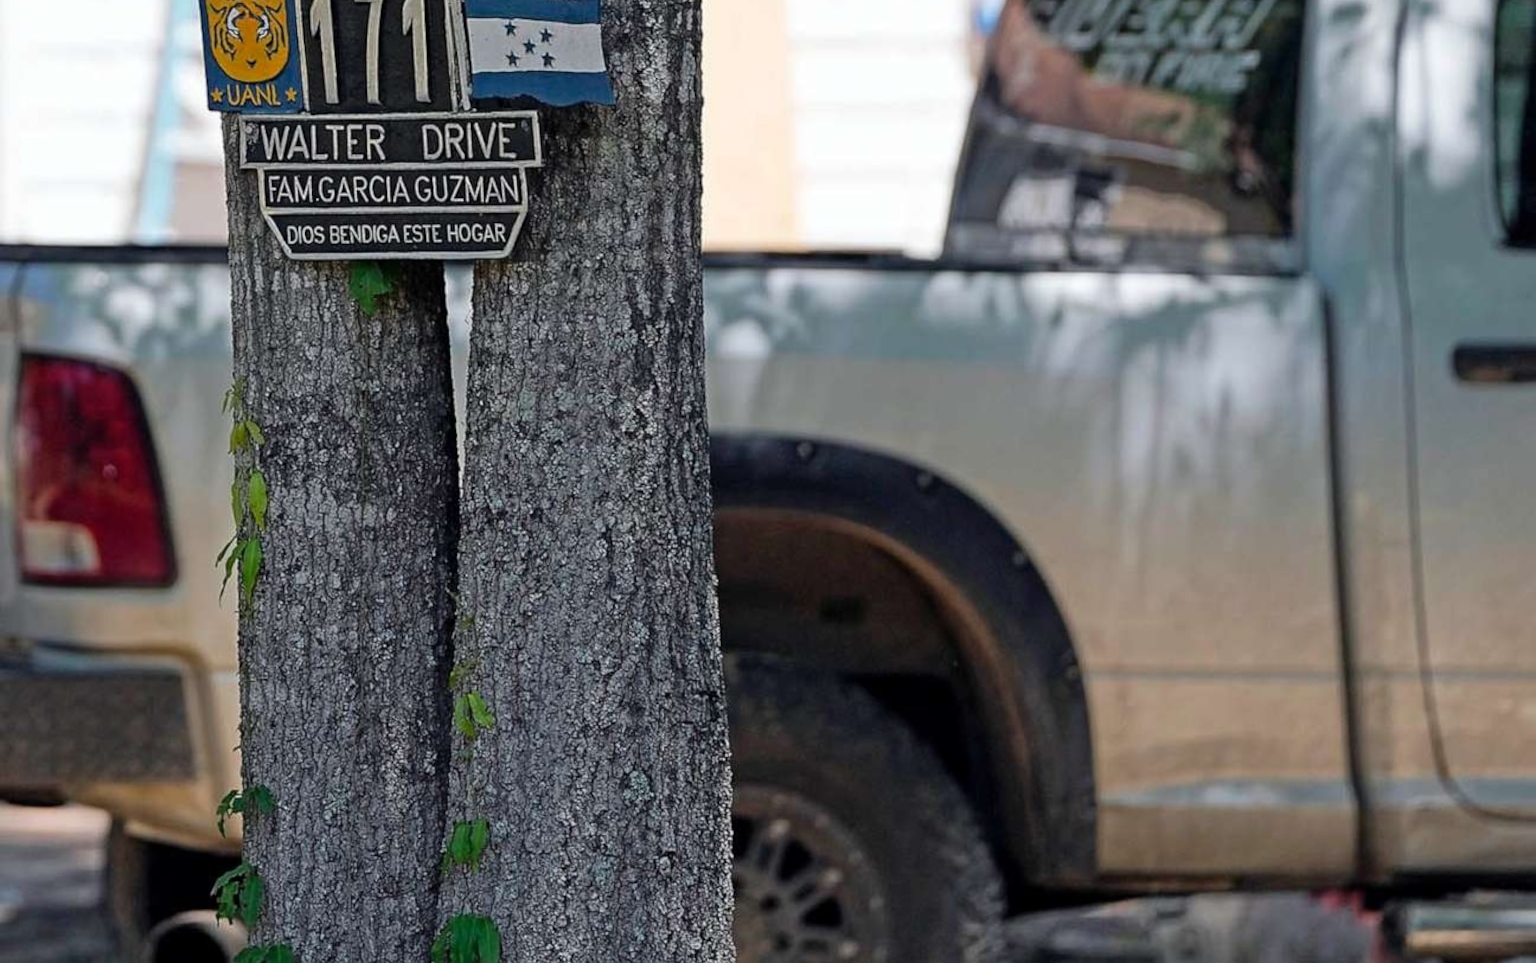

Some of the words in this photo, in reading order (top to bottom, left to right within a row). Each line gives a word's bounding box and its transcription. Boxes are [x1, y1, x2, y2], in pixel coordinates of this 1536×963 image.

[226, 84, 282, 107] UANL
[260, 124, 386, 161] WALTER
[421, 122, 517, 160] DRIVE
[414, 174, 520, 203] GUZMAN
[286, 225, 325, 245] DIOS
[329, 224, 401, 245] BENDIGA
[403, 224, 443, 244] ESTE
[446, 223, 506, 243] HOGAR
